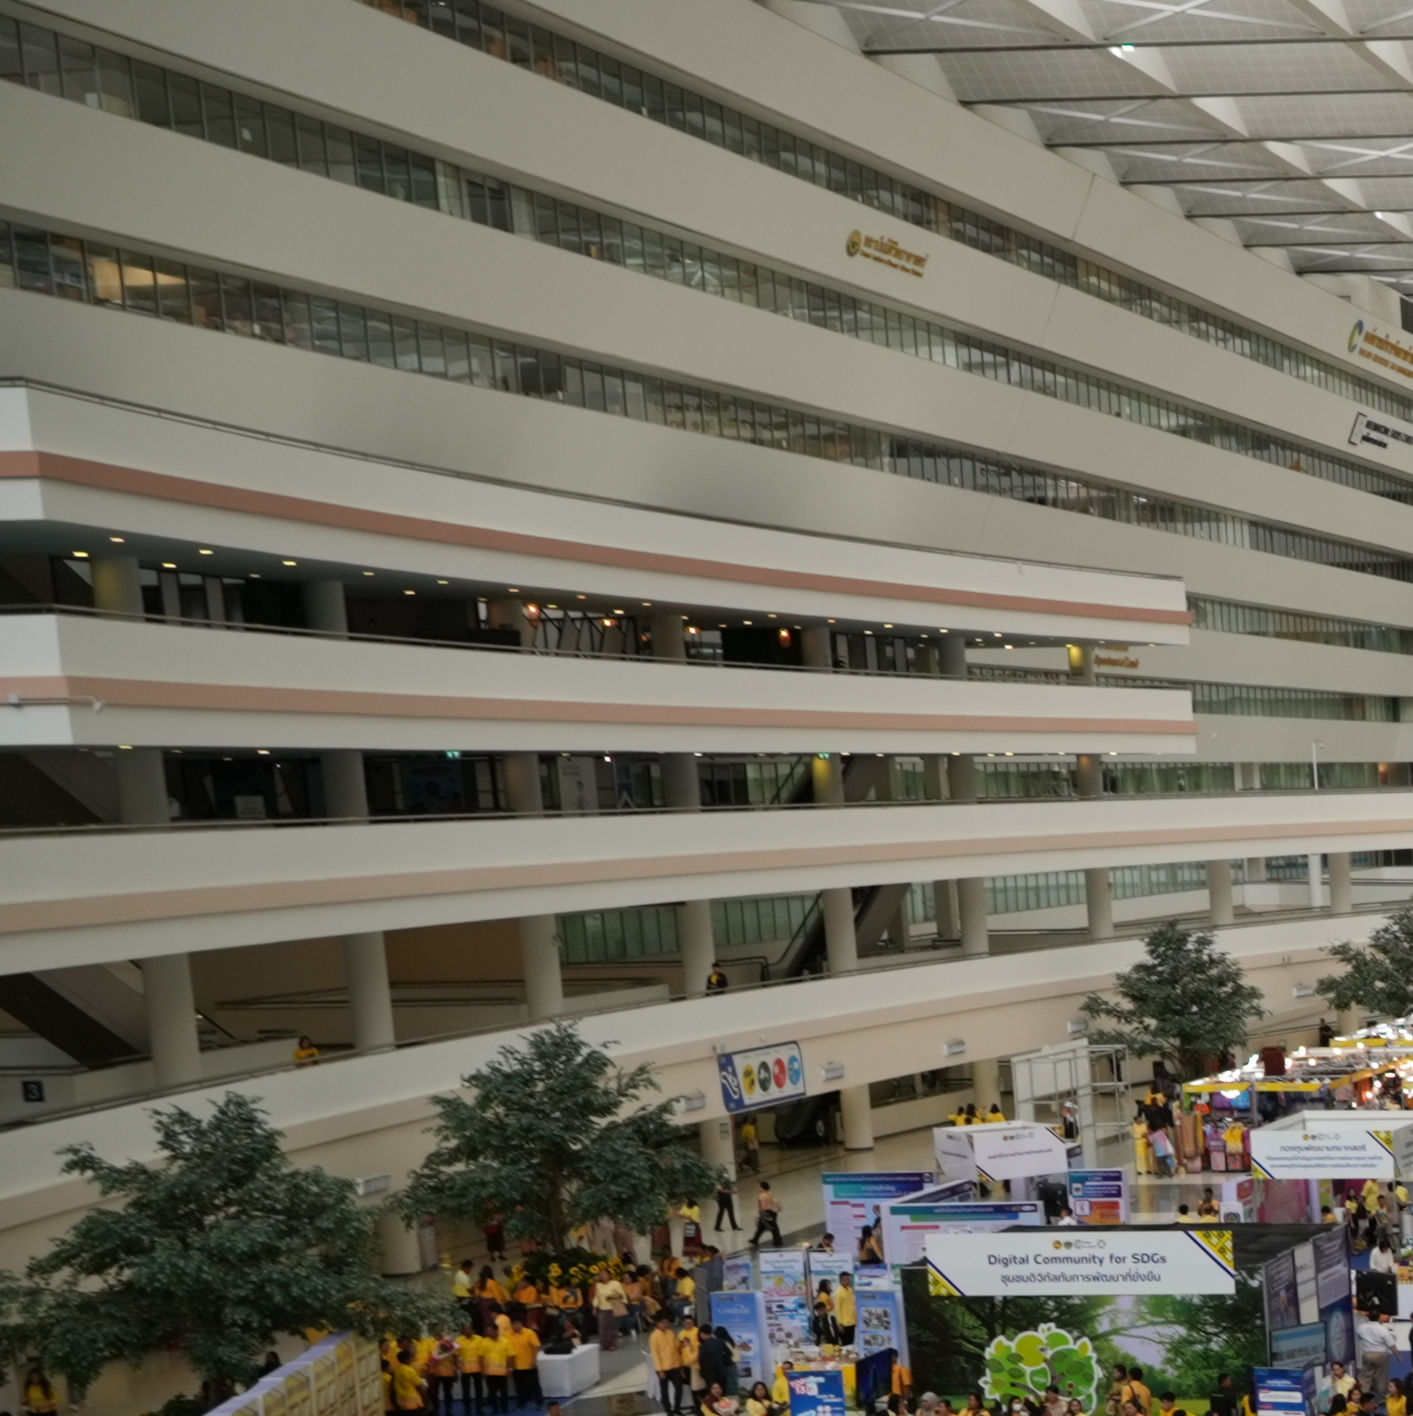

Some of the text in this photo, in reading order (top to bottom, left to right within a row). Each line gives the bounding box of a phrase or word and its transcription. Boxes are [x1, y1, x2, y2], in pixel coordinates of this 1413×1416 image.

[987, 1252, 1167, 1267] Digital Community for SDGs
[1000, 1268, 1162, 1286] ชุมชนดิจิทัลกับการพัฒนาที่ยั่งยืน
